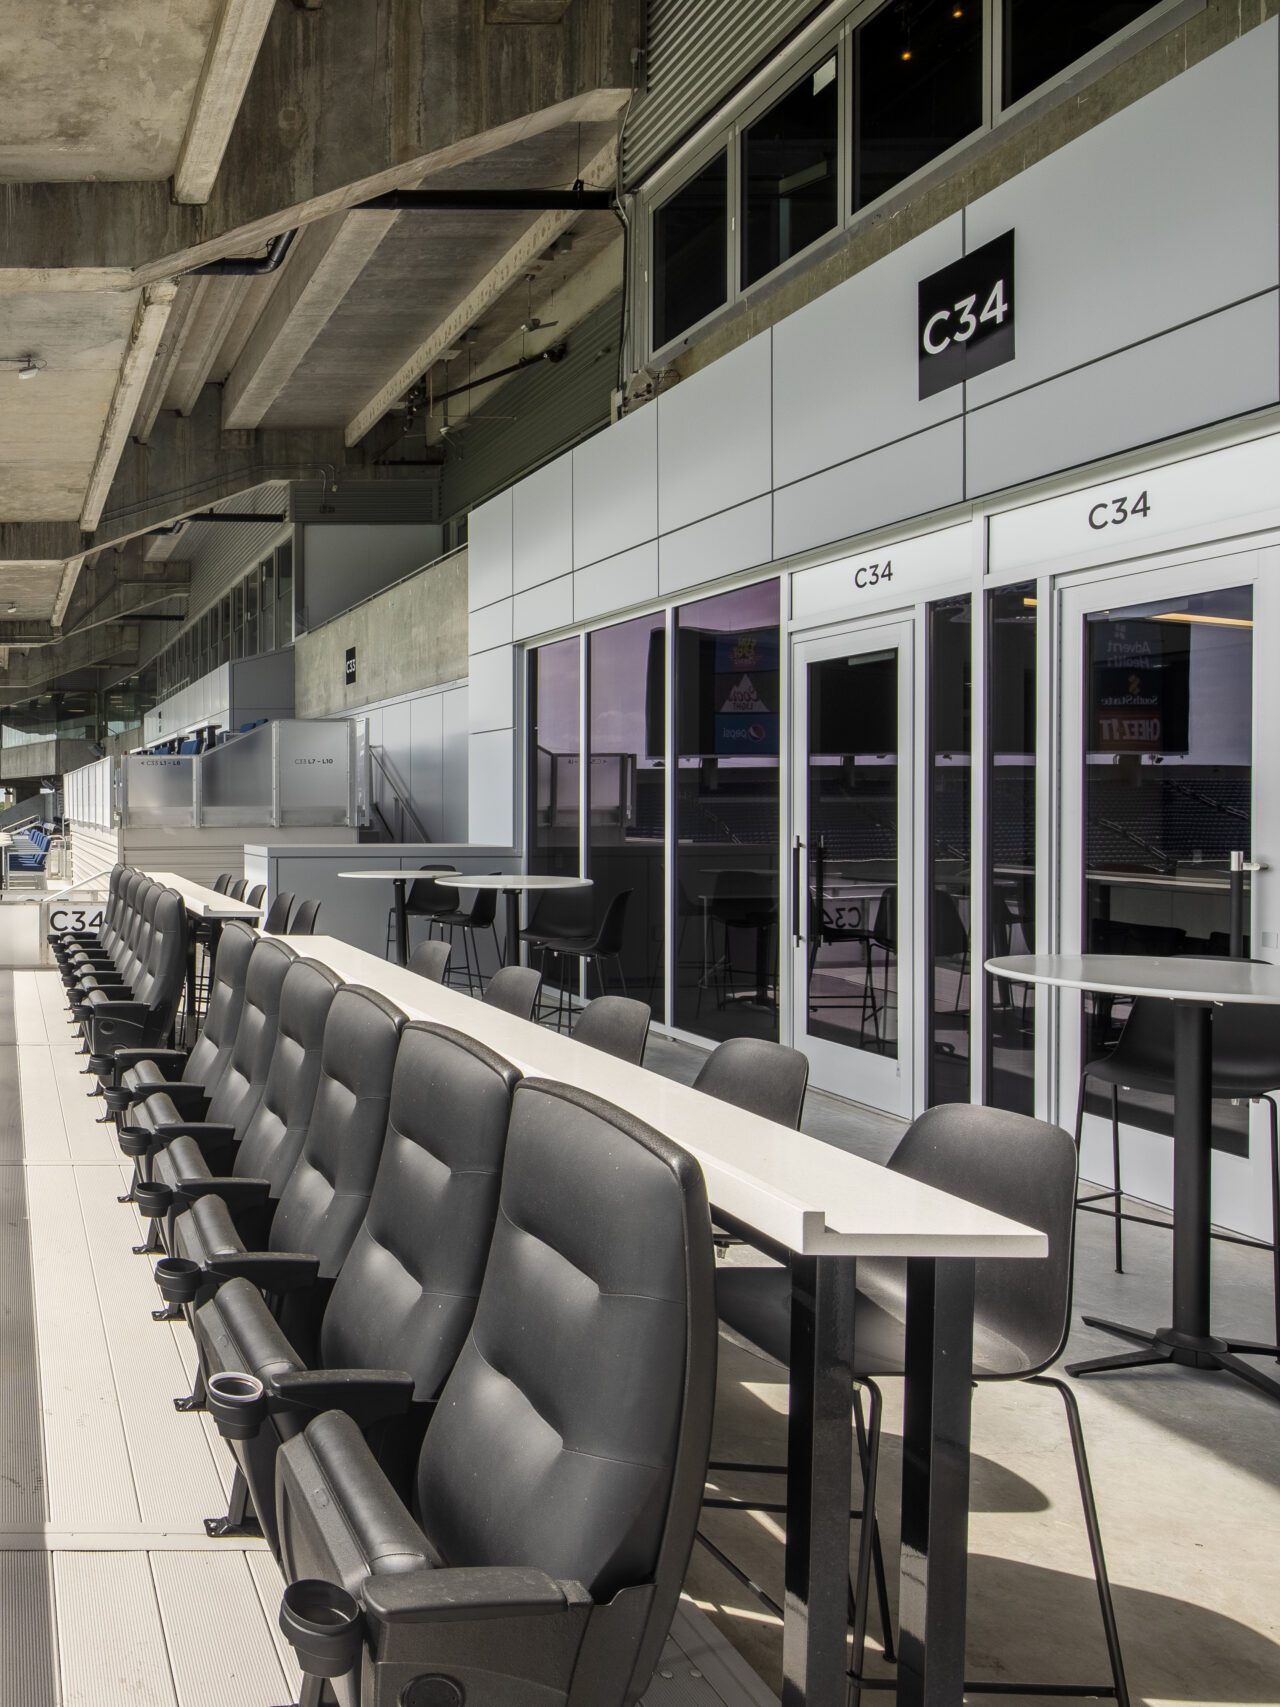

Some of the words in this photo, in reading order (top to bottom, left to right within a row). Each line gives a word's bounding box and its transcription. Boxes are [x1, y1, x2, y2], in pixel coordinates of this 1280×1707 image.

[923, 279, 1008, 355] C34
[1088, 490, 1151, 530] C34
[854, 560, 894, 588] C34
[50, 910, 103, 932] C34
